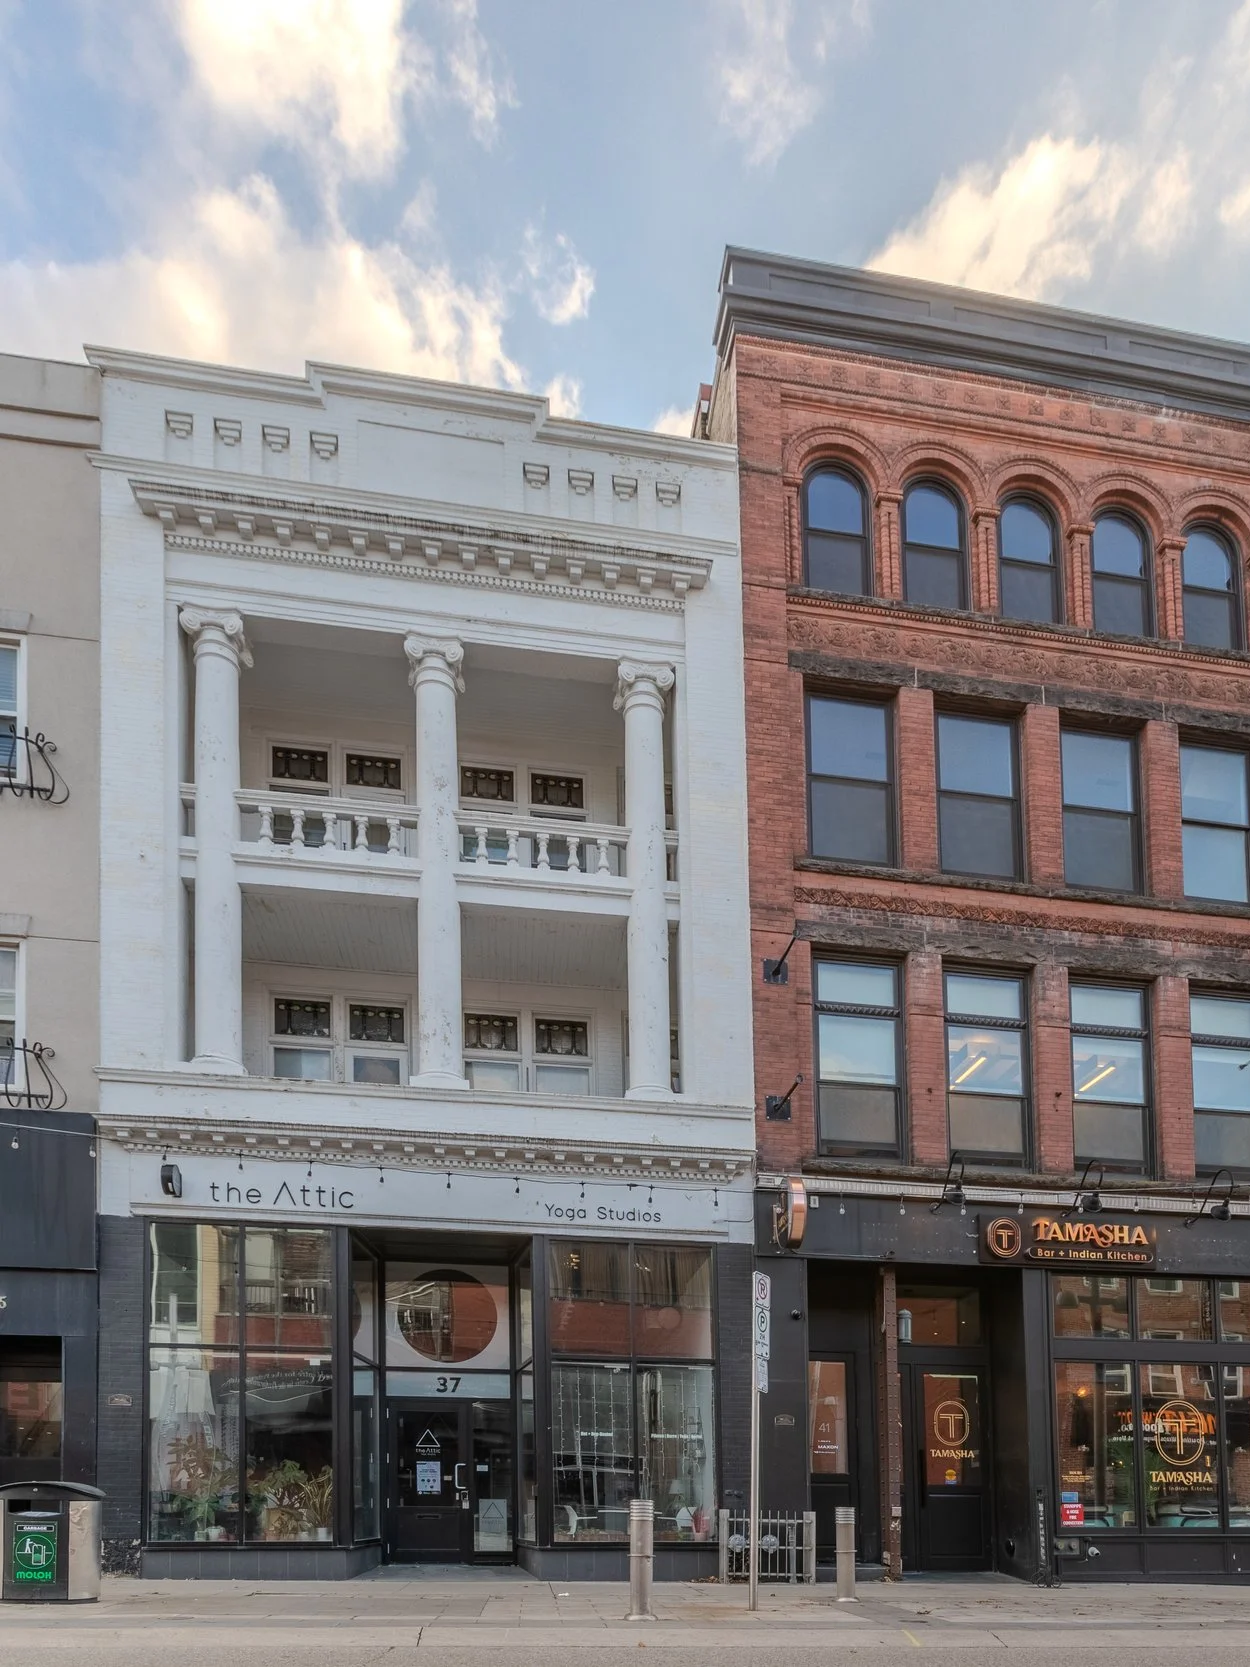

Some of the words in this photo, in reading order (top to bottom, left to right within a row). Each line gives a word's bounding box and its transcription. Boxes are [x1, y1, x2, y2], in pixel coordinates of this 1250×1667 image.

[209, 1181, 262, 1204] the
[273, 1181, 354, 1209] Attic
[544, 1203, 587, 1221] Yoga
[597, 1206, 661, 1223] Studios
[1031, 1219, 1150, 1248] TAMASHA
[1037, 1248, 1055, 1258] Bar
[1069, 1249, 1103, 1260] Indian
[1107, 1251, 1148, 1262] Kitchen
[436, 1376, 462, 1394] 37
[818, 1422, 832, 1433] 41
[930, 1448, 975, 1460] TAMASHA
[1149, 1471, 1213, 1486] TAMASHA
